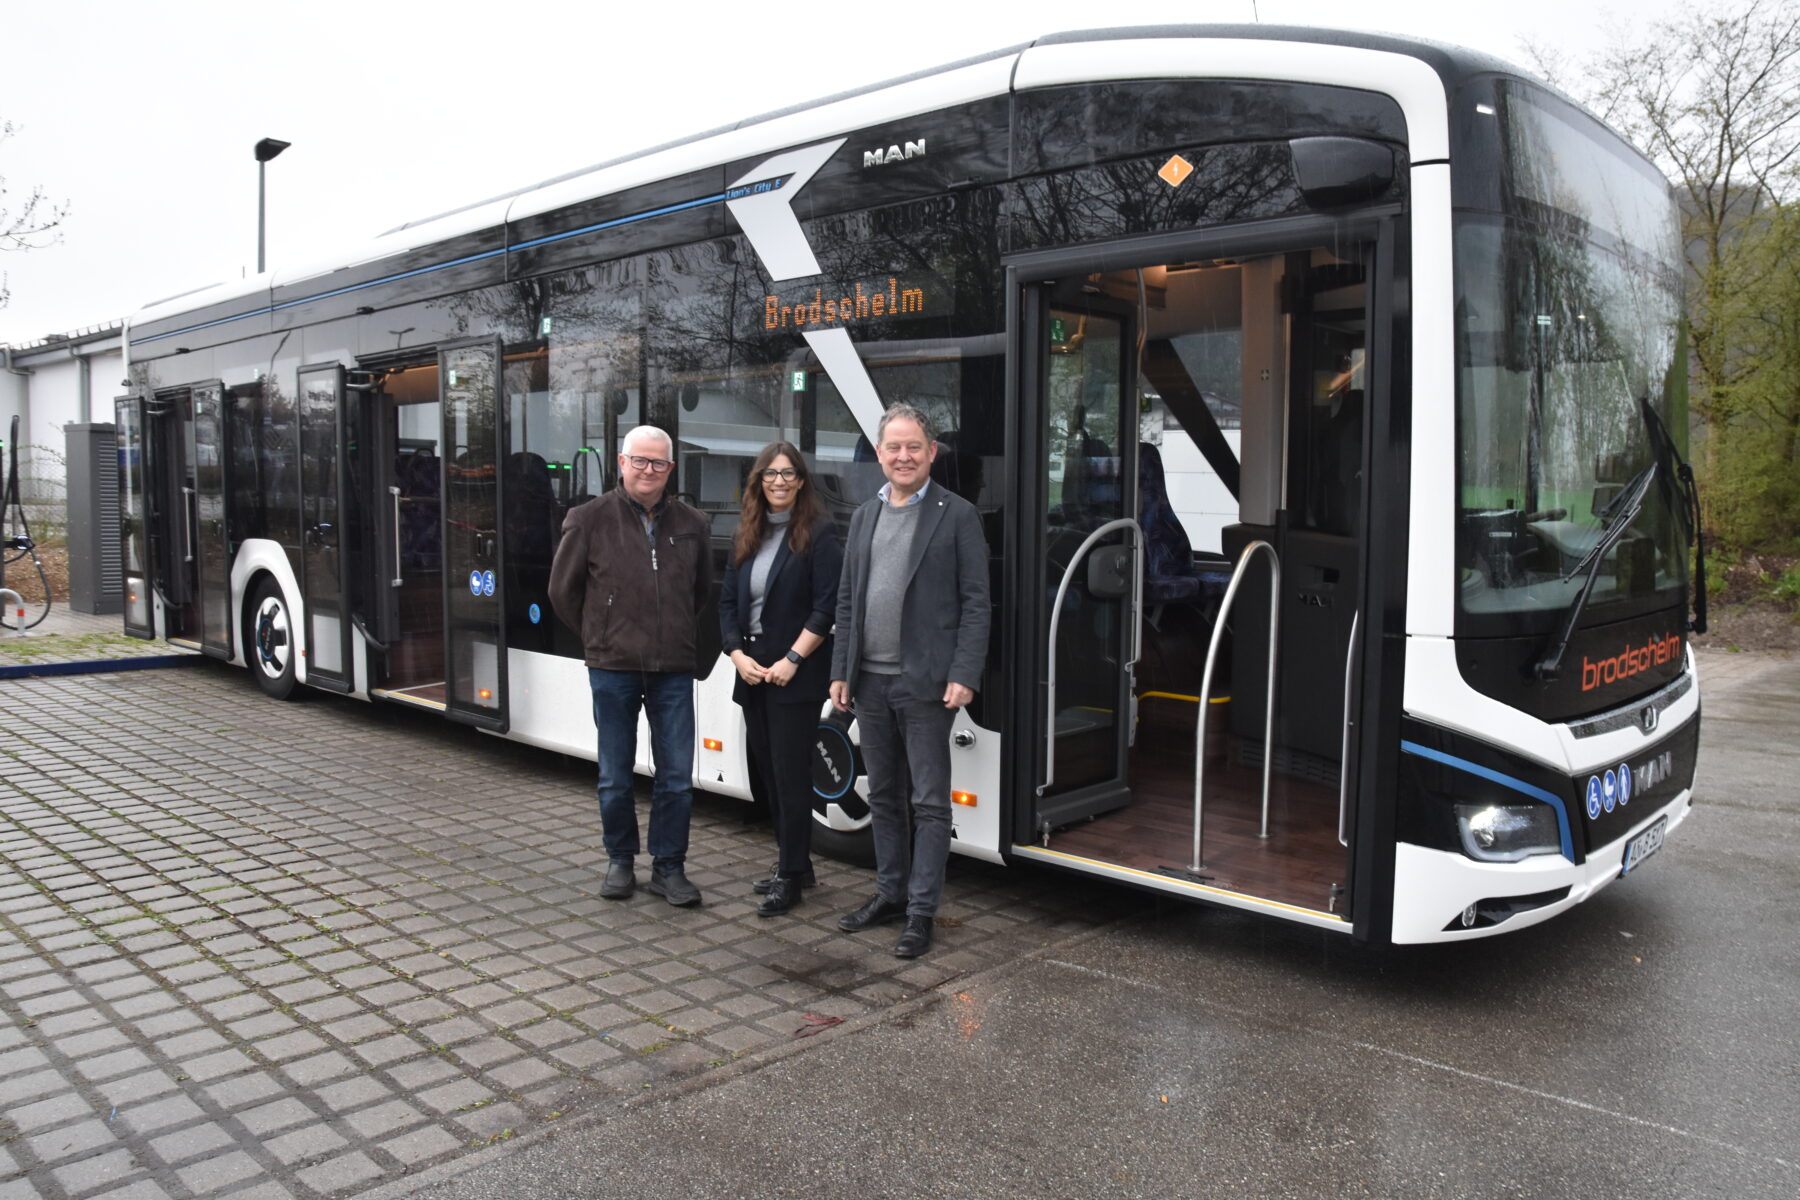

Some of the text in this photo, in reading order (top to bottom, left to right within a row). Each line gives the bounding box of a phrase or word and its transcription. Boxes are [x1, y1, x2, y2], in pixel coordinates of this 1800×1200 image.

[863, 138, 926, 168] MAN
[775, 178, 783, 189] E
[765, 277, 924, 329] Brodschelm
[1582, 631, 1680, 692] brodschelm
[816, 740, 841, 783] MAN
[1633, 751, 1672, 797] MAN
